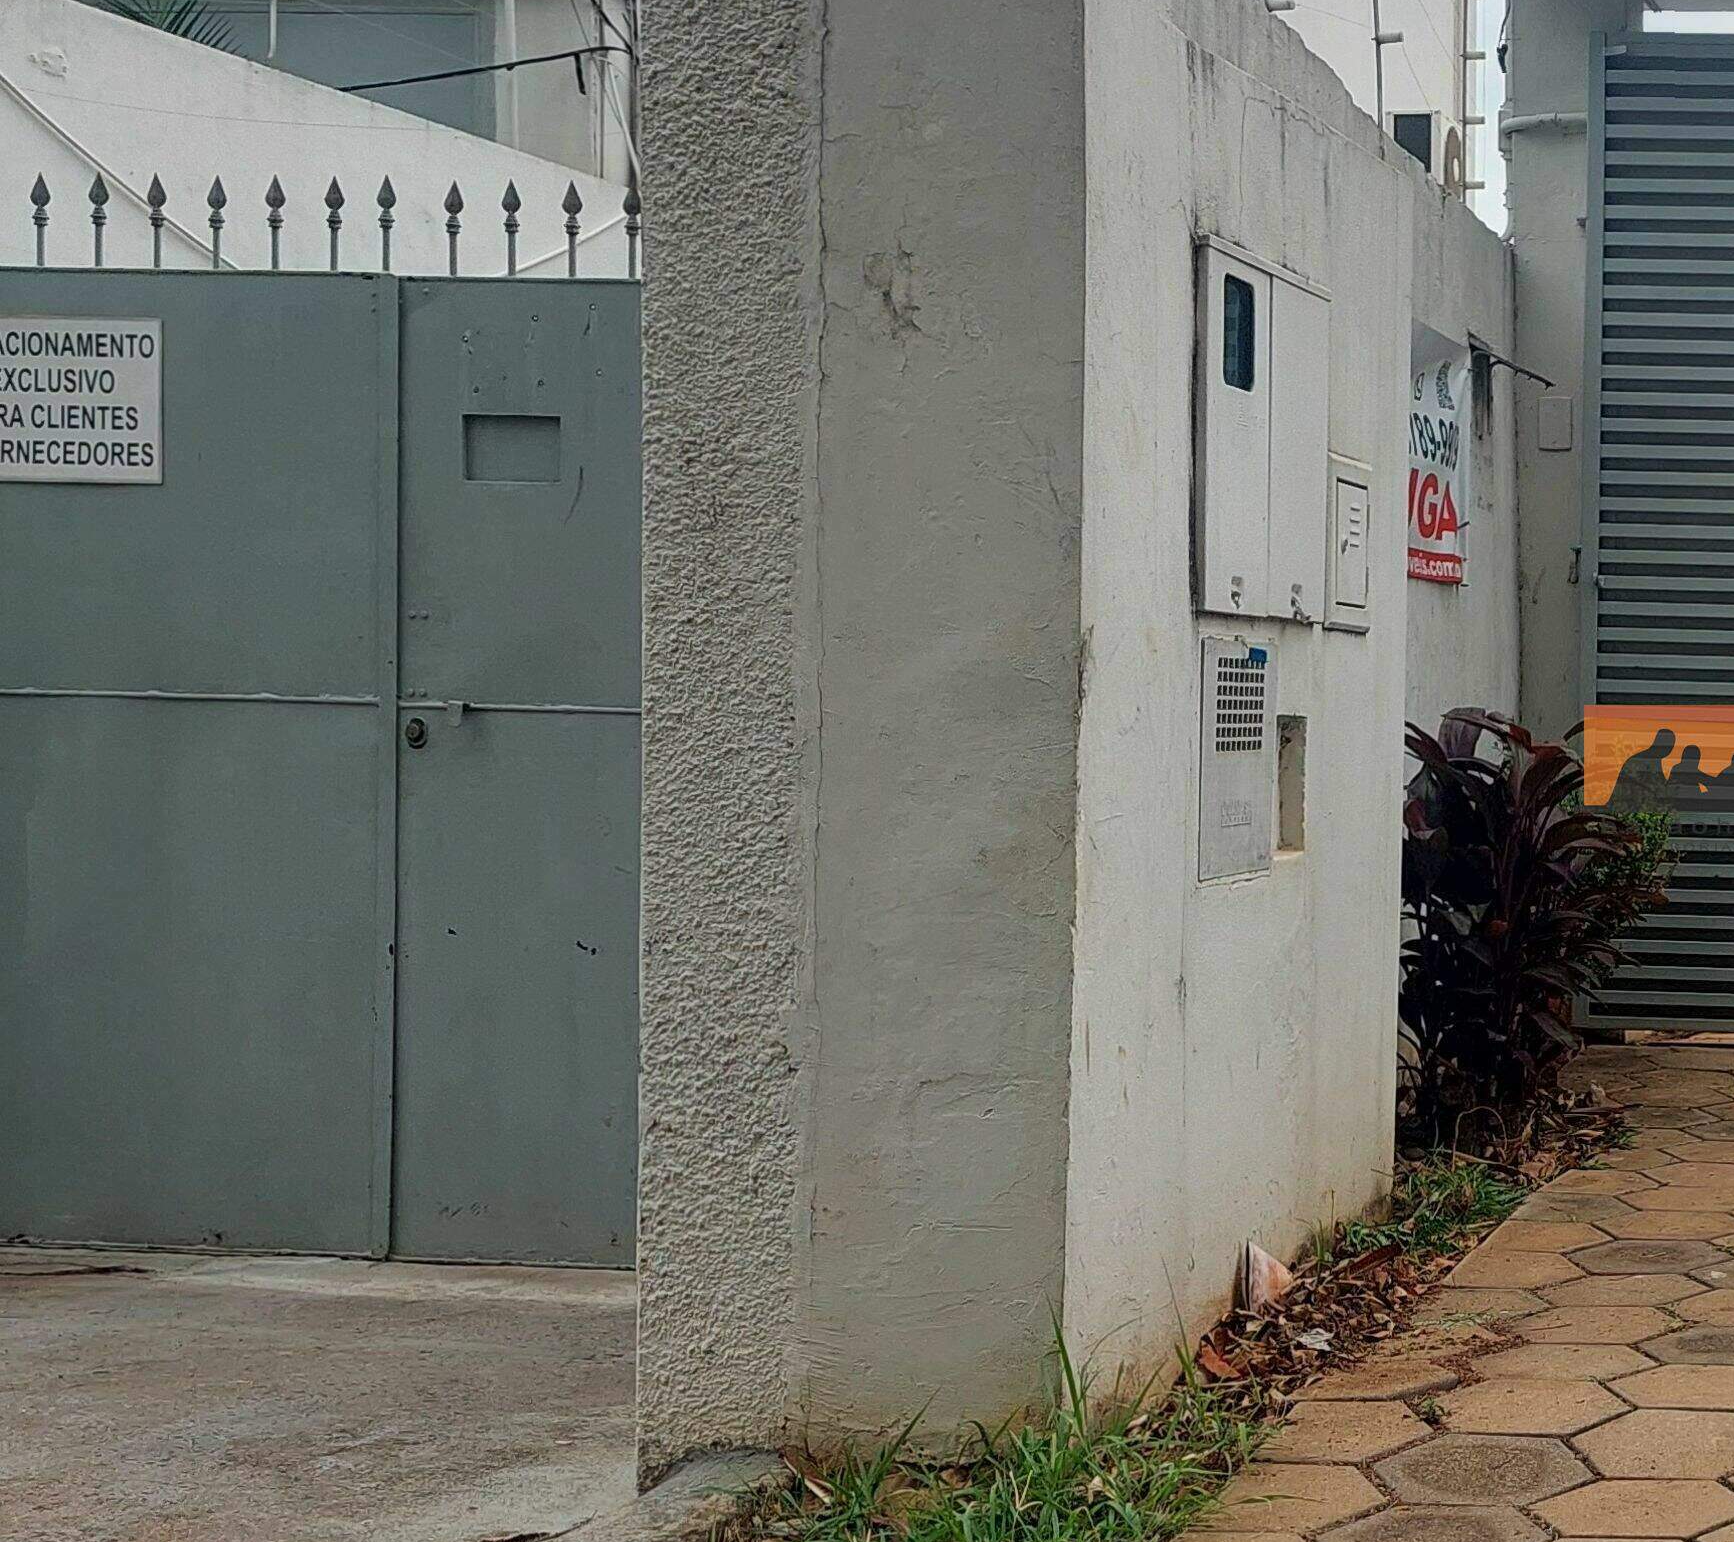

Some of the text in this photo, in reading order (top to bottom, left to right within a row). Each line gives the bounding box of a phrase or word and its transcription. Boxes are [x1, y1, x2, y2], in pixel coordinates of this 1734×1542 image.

[0, 367, 115, 393] XCLUSIVO
[31, 404, 138, 431] CLIENTES
[0, 439, 154, 467] RNECEDORES
